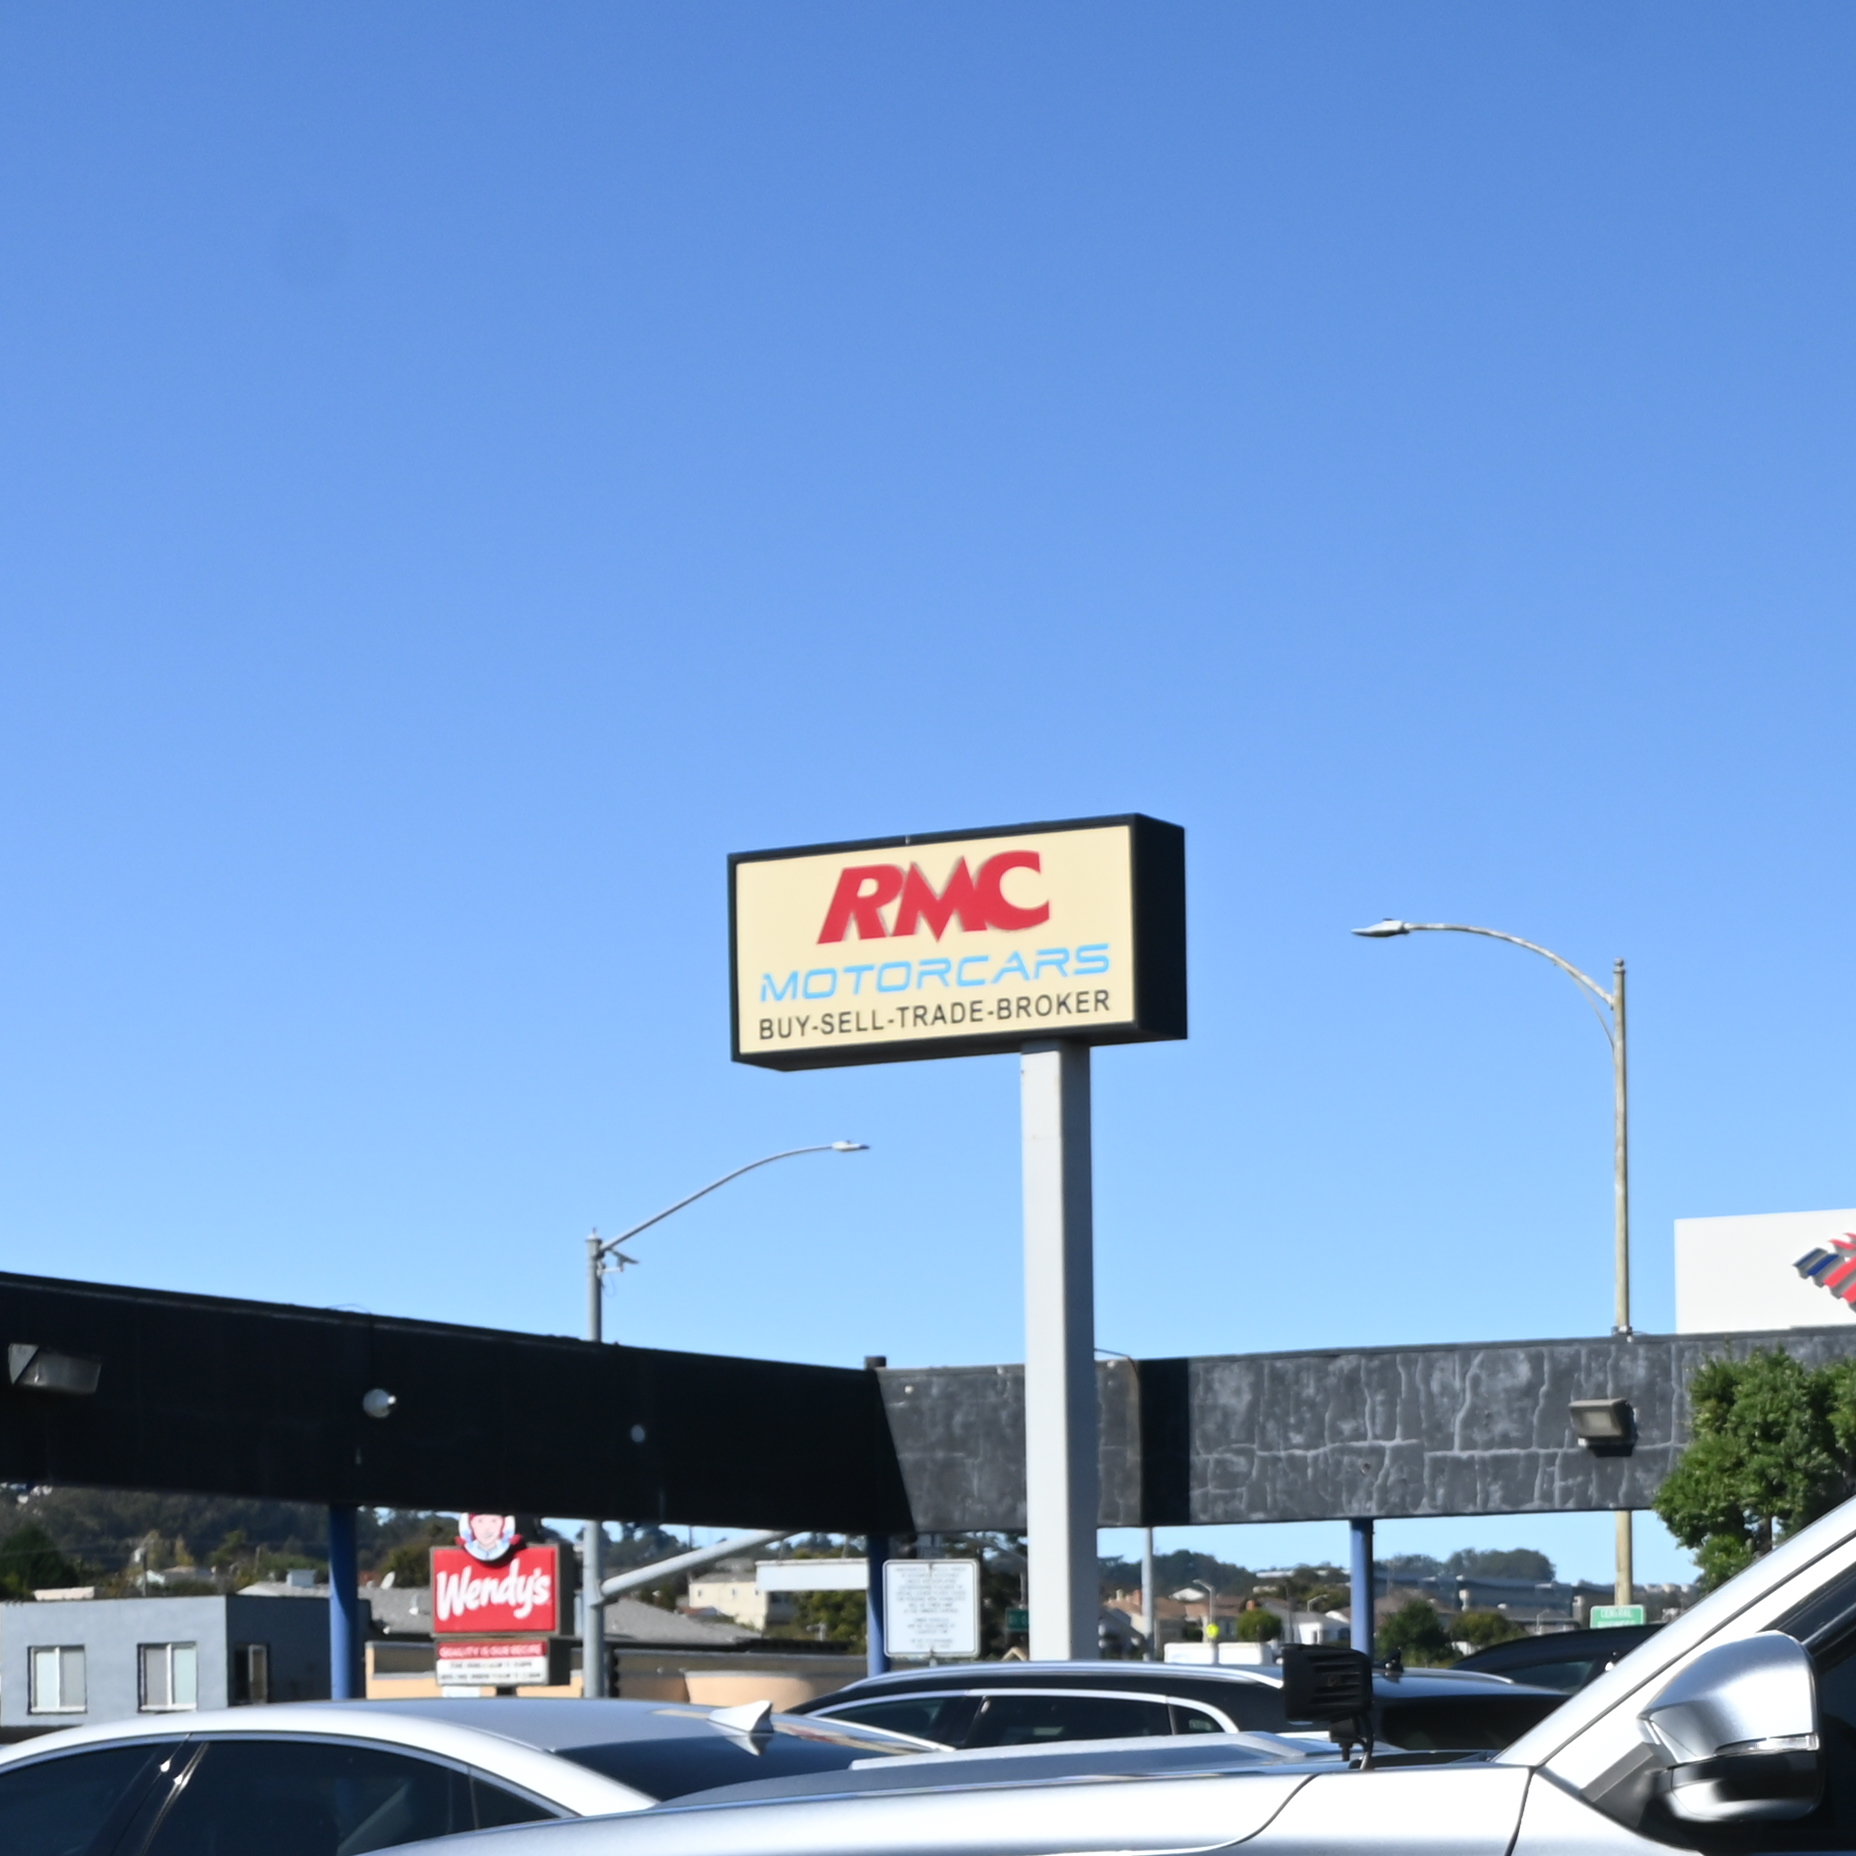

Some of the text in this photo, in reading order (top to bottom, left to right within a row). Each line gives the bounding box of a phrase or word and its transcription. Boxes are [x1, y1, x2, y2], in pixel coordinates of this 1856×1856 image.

[817, 850, 1049, 943] RMC
[760, 943, 1111, 1002] MOTORCARS
[759, 989, 1111, 1040] BUY-SELL-TRADE-BROKER
[436, 1558, 551, 1622] Wendy's
